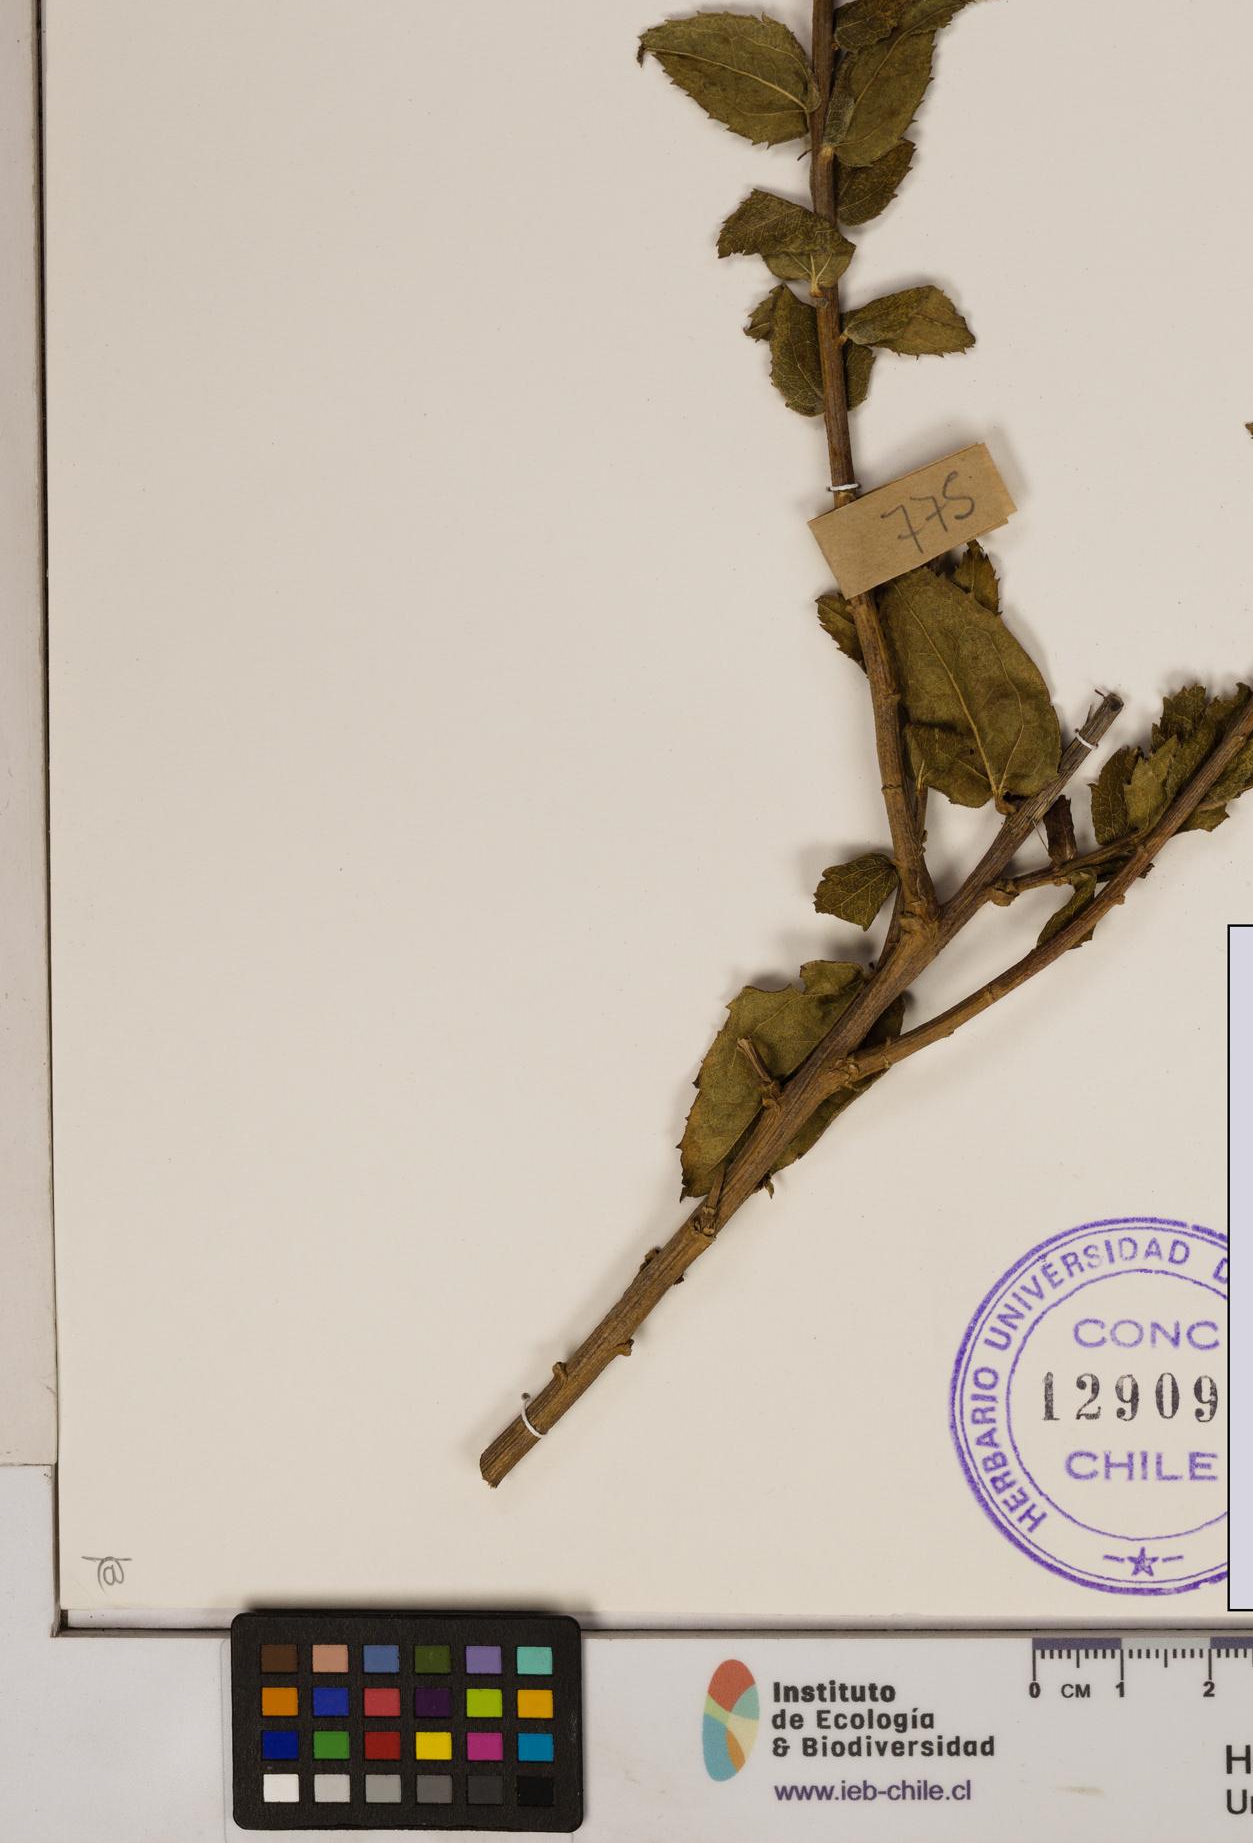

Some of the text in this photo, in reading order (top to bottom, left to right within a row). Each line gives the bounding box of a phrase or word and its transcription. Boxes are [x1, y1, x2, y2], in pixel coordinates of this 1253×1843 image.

[880, 469, 976, 555] 775
[1073, 1318, 1220, 1351] CONC
[971, 1236, 1191, 1533] HERBARIO UNIVERSIDAD
[1065, 1451, 1218, 1481] CHILE
[773, 1679, 896, 1703] Instituto
[1028, 1681, 1042, 1699] 0
[1060, 1683, 1091, 1699] CM
[1115, 1680, 1125, 1698] 1
[1202, 1680, 1216, 1698] 2
[771, 1707, 935, 1734] de Ecología
[772, 1735, 995, 1758] & Biodiversidad
[773, 1779, 972, 1801] www.ieb-chile.cl
